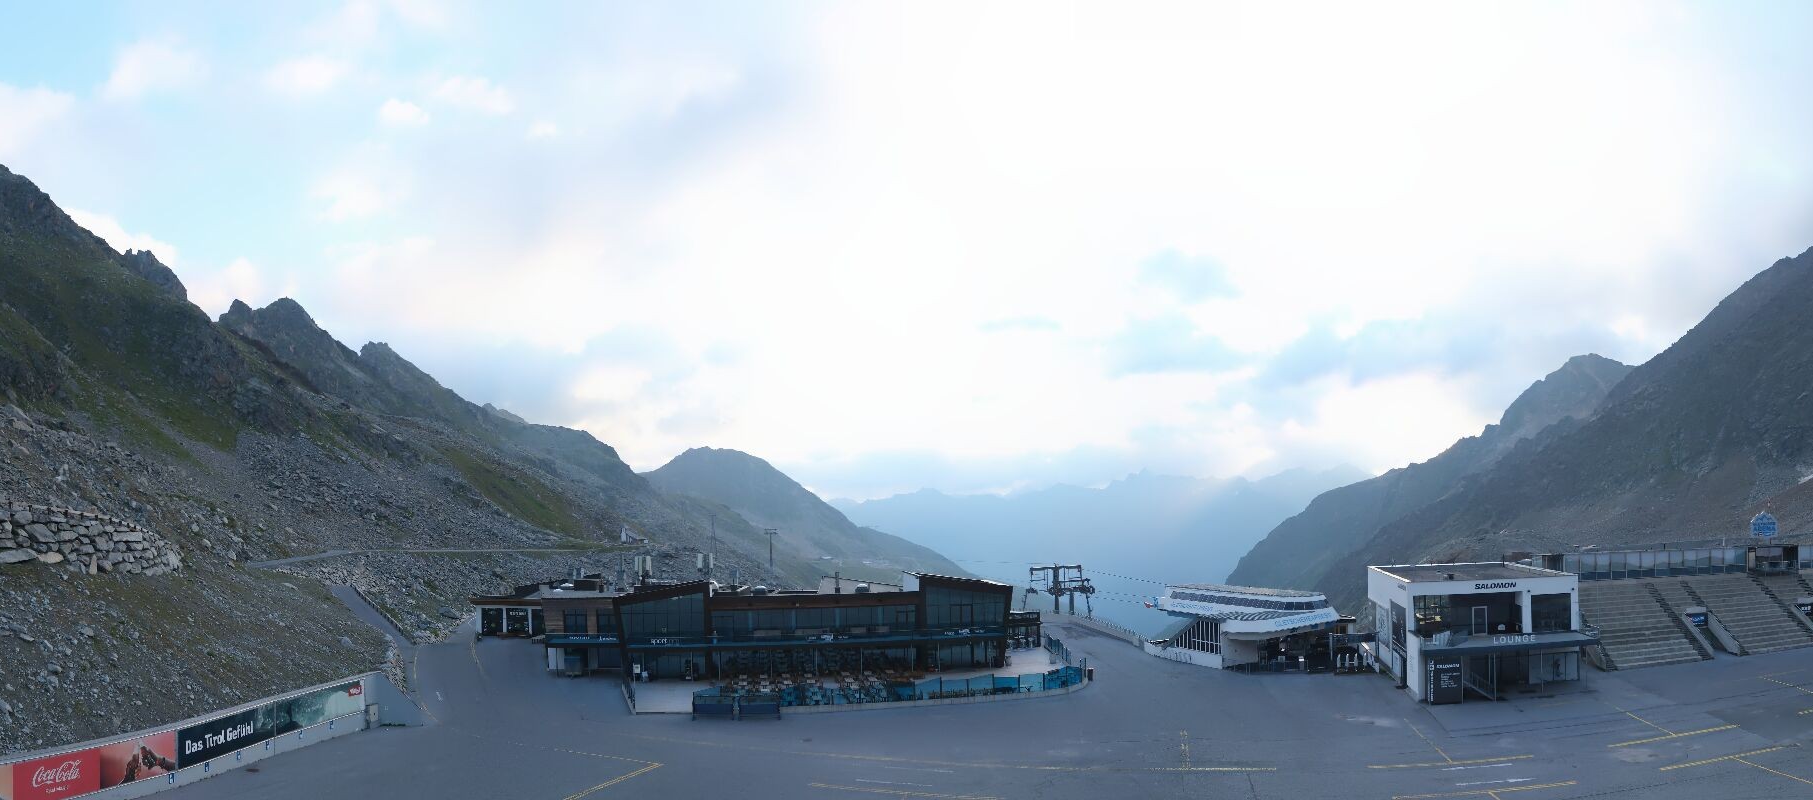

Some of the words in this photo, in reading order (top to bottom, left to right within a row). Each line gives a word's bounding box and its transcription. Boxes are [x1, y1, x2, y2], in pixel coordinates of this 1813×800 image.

[1475, 582, 1517, 590] SALOMON
[1493, 634, 1536, 644] LOUNGE
[185, 740, 203, 755] Das
[205, 729, 225, 749] Tirol
[227, 721, 254, 741] Gefühl
